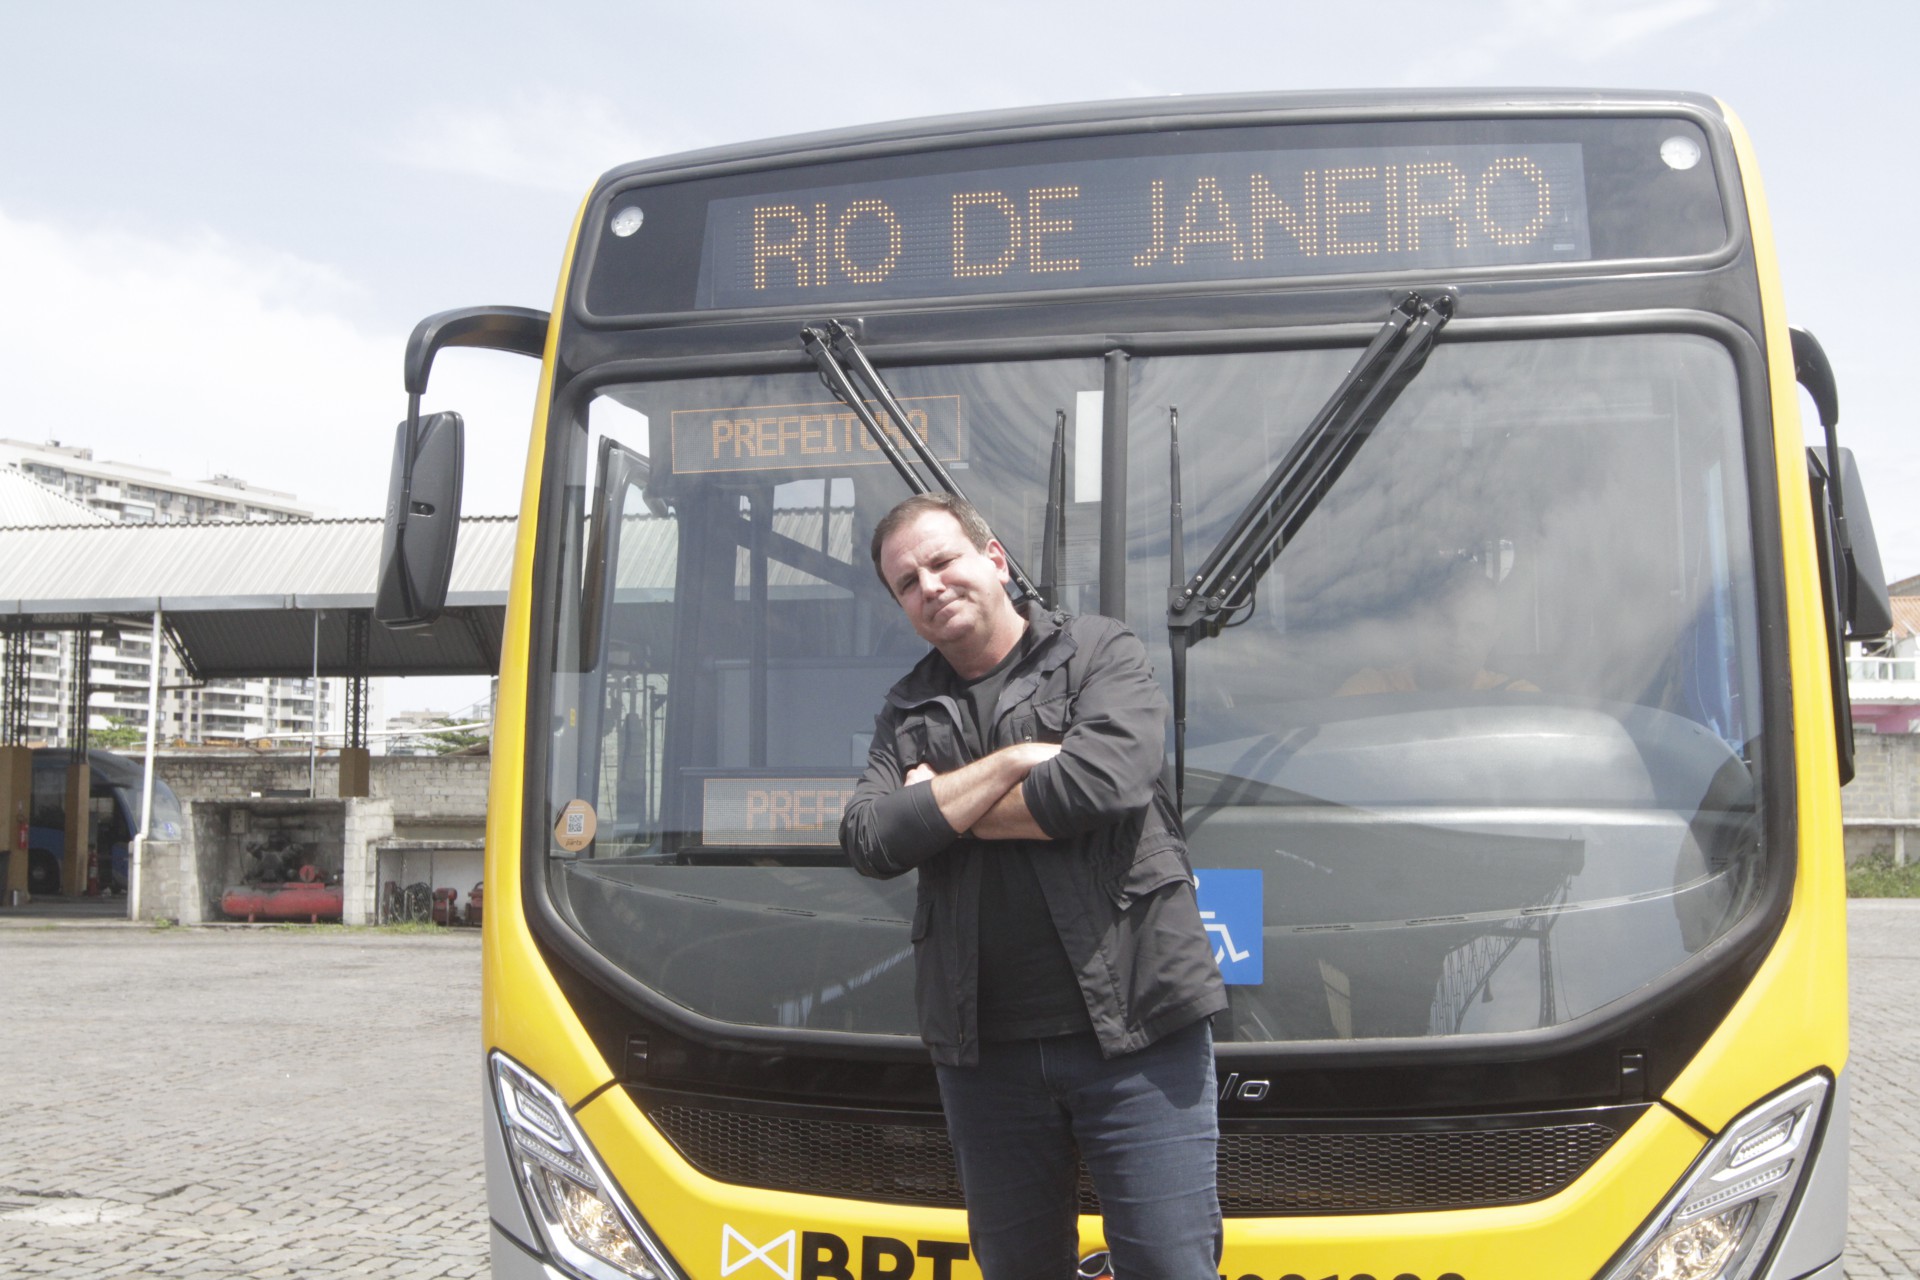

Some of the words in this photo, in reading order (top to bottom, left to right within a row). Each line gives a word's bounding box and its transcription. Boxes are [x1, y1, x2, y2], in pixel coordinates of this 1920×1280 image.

[754, 200, 901, 289] RIO
[953, 185, 1080, 273] DE
[1133, 155, 1550, 267] JANEIRO
